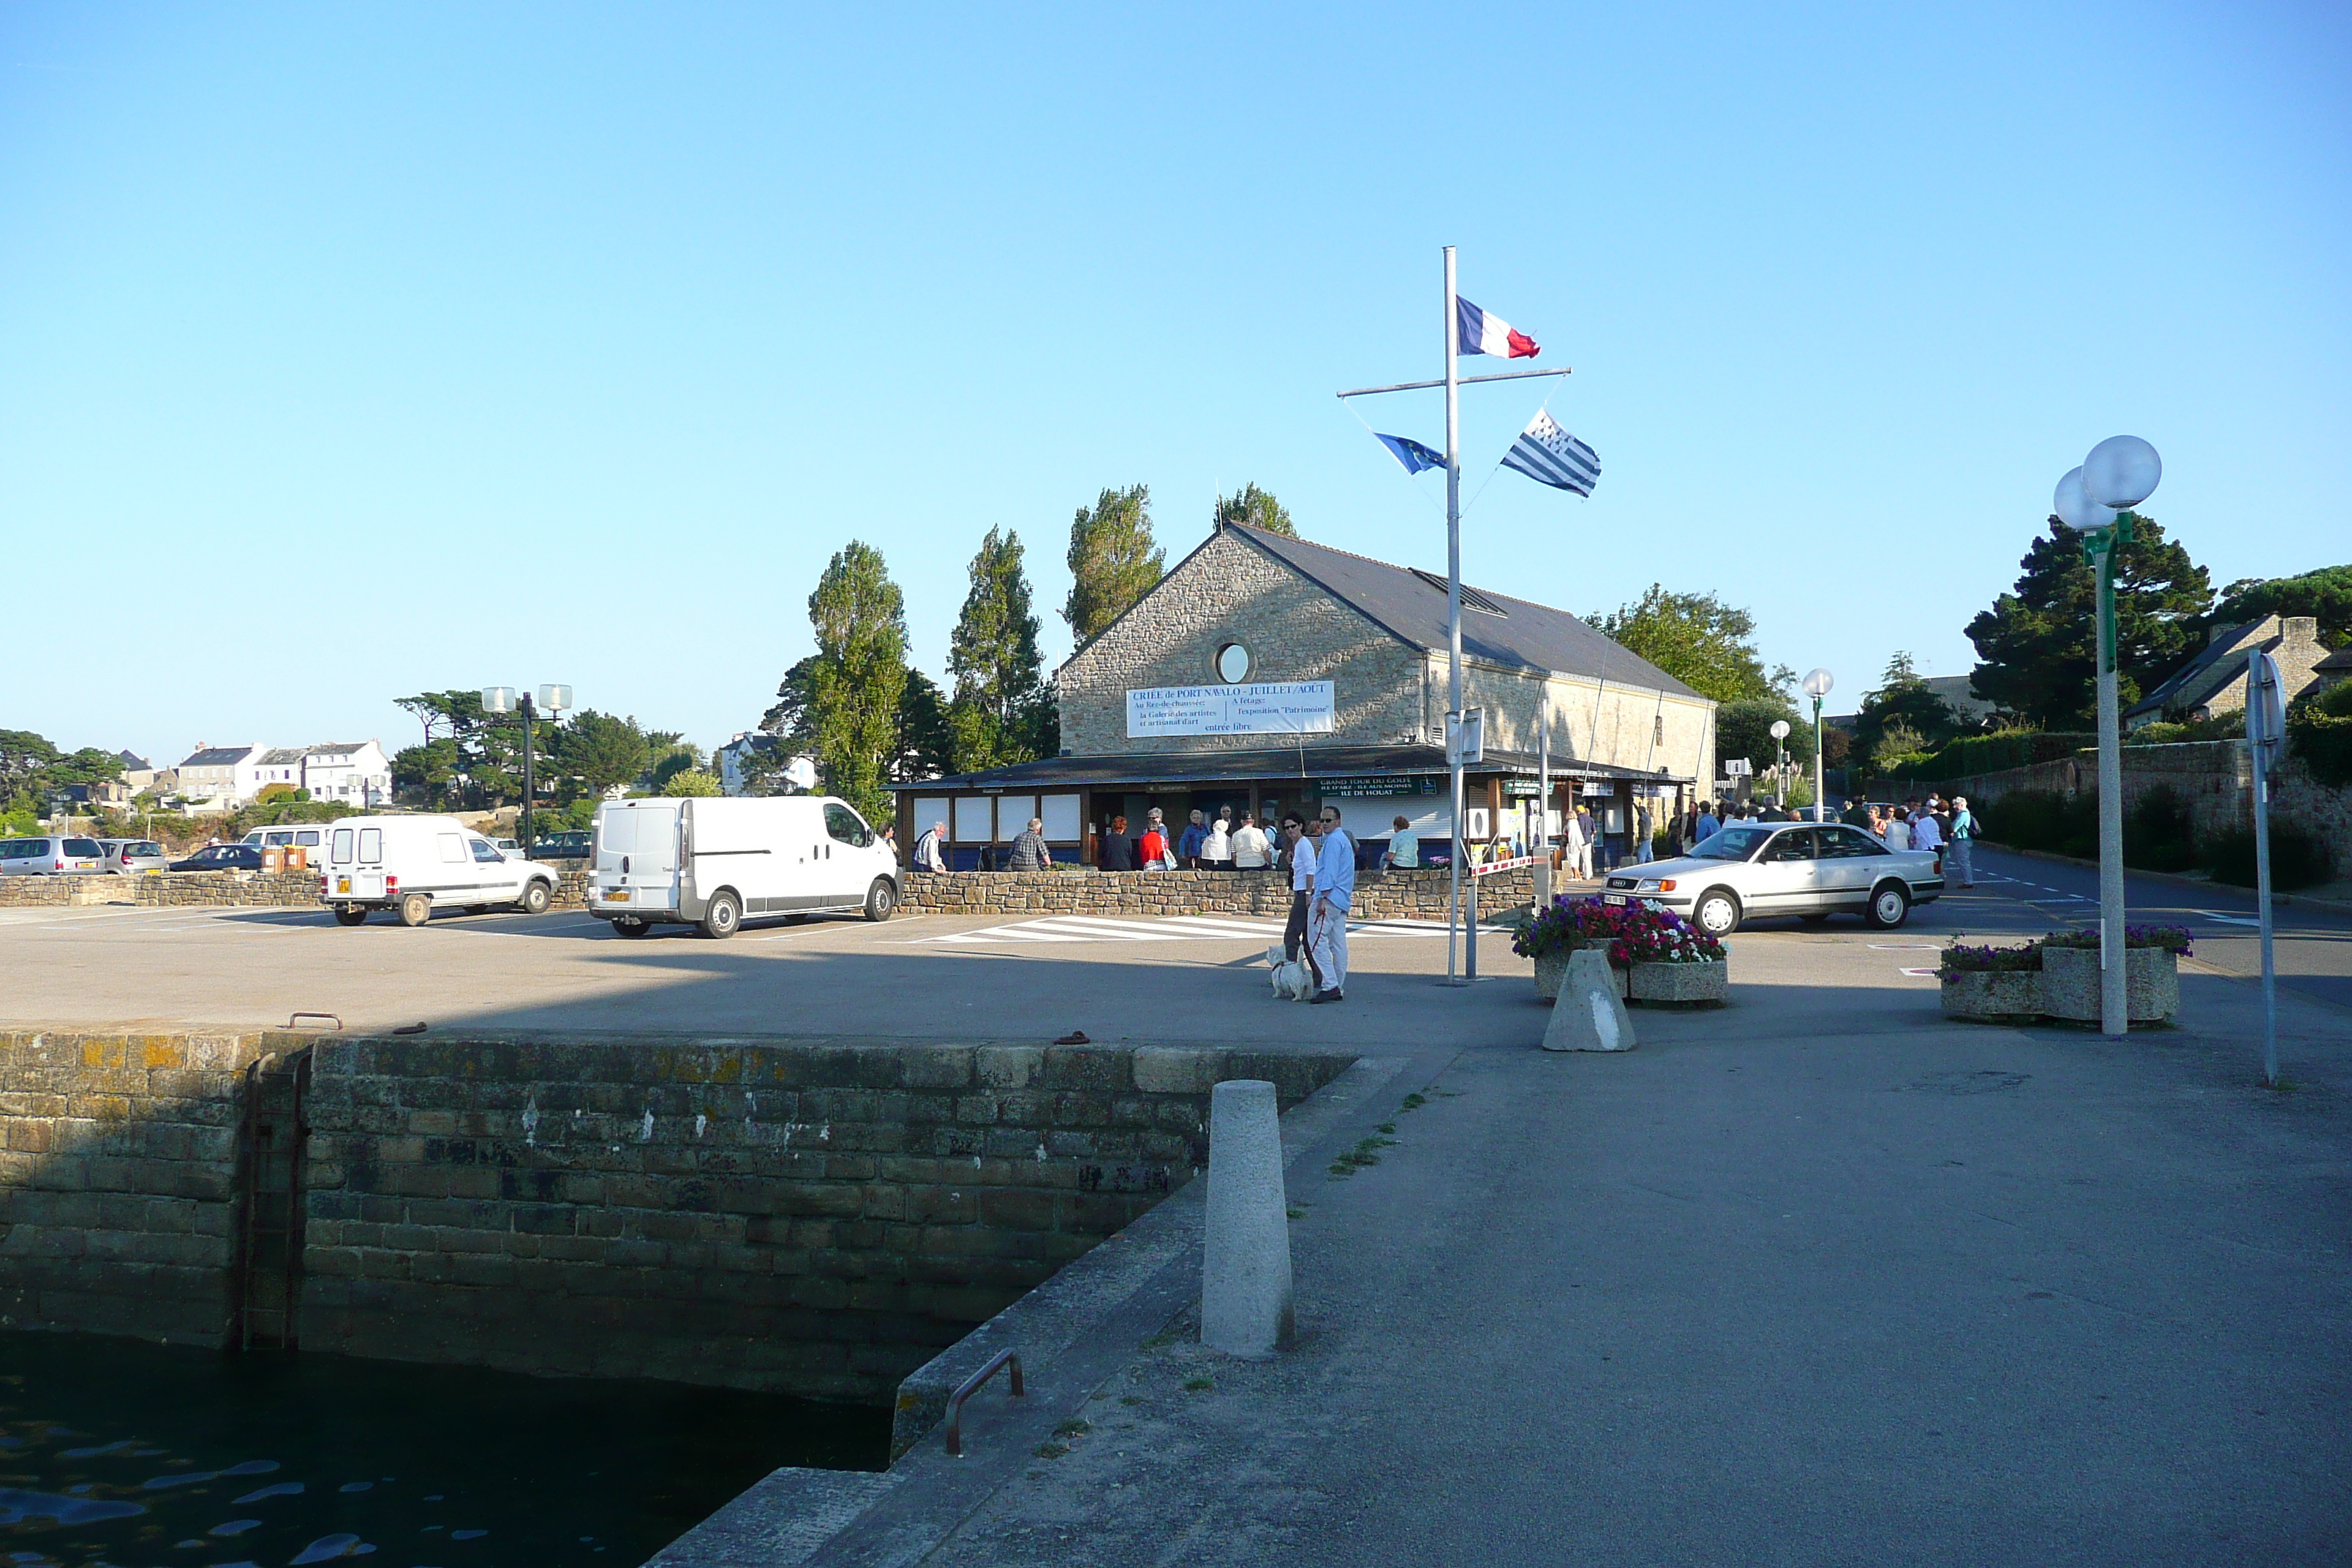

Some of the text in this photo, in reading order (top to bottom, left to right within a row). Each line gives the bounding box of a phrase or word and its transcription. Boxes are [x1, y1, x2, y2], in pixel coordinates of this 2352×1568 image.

[1133, 689, 1163, 700] CRIÉE
[1165, 690, 1175, 698] de
[1177, 689, 1202, 698] PORT
[1205, 687, 1240, 697] NAVALO
[1238, 707, 1279, 716] l'exposition
[1205, 722, 1252, 731] entrée libre
